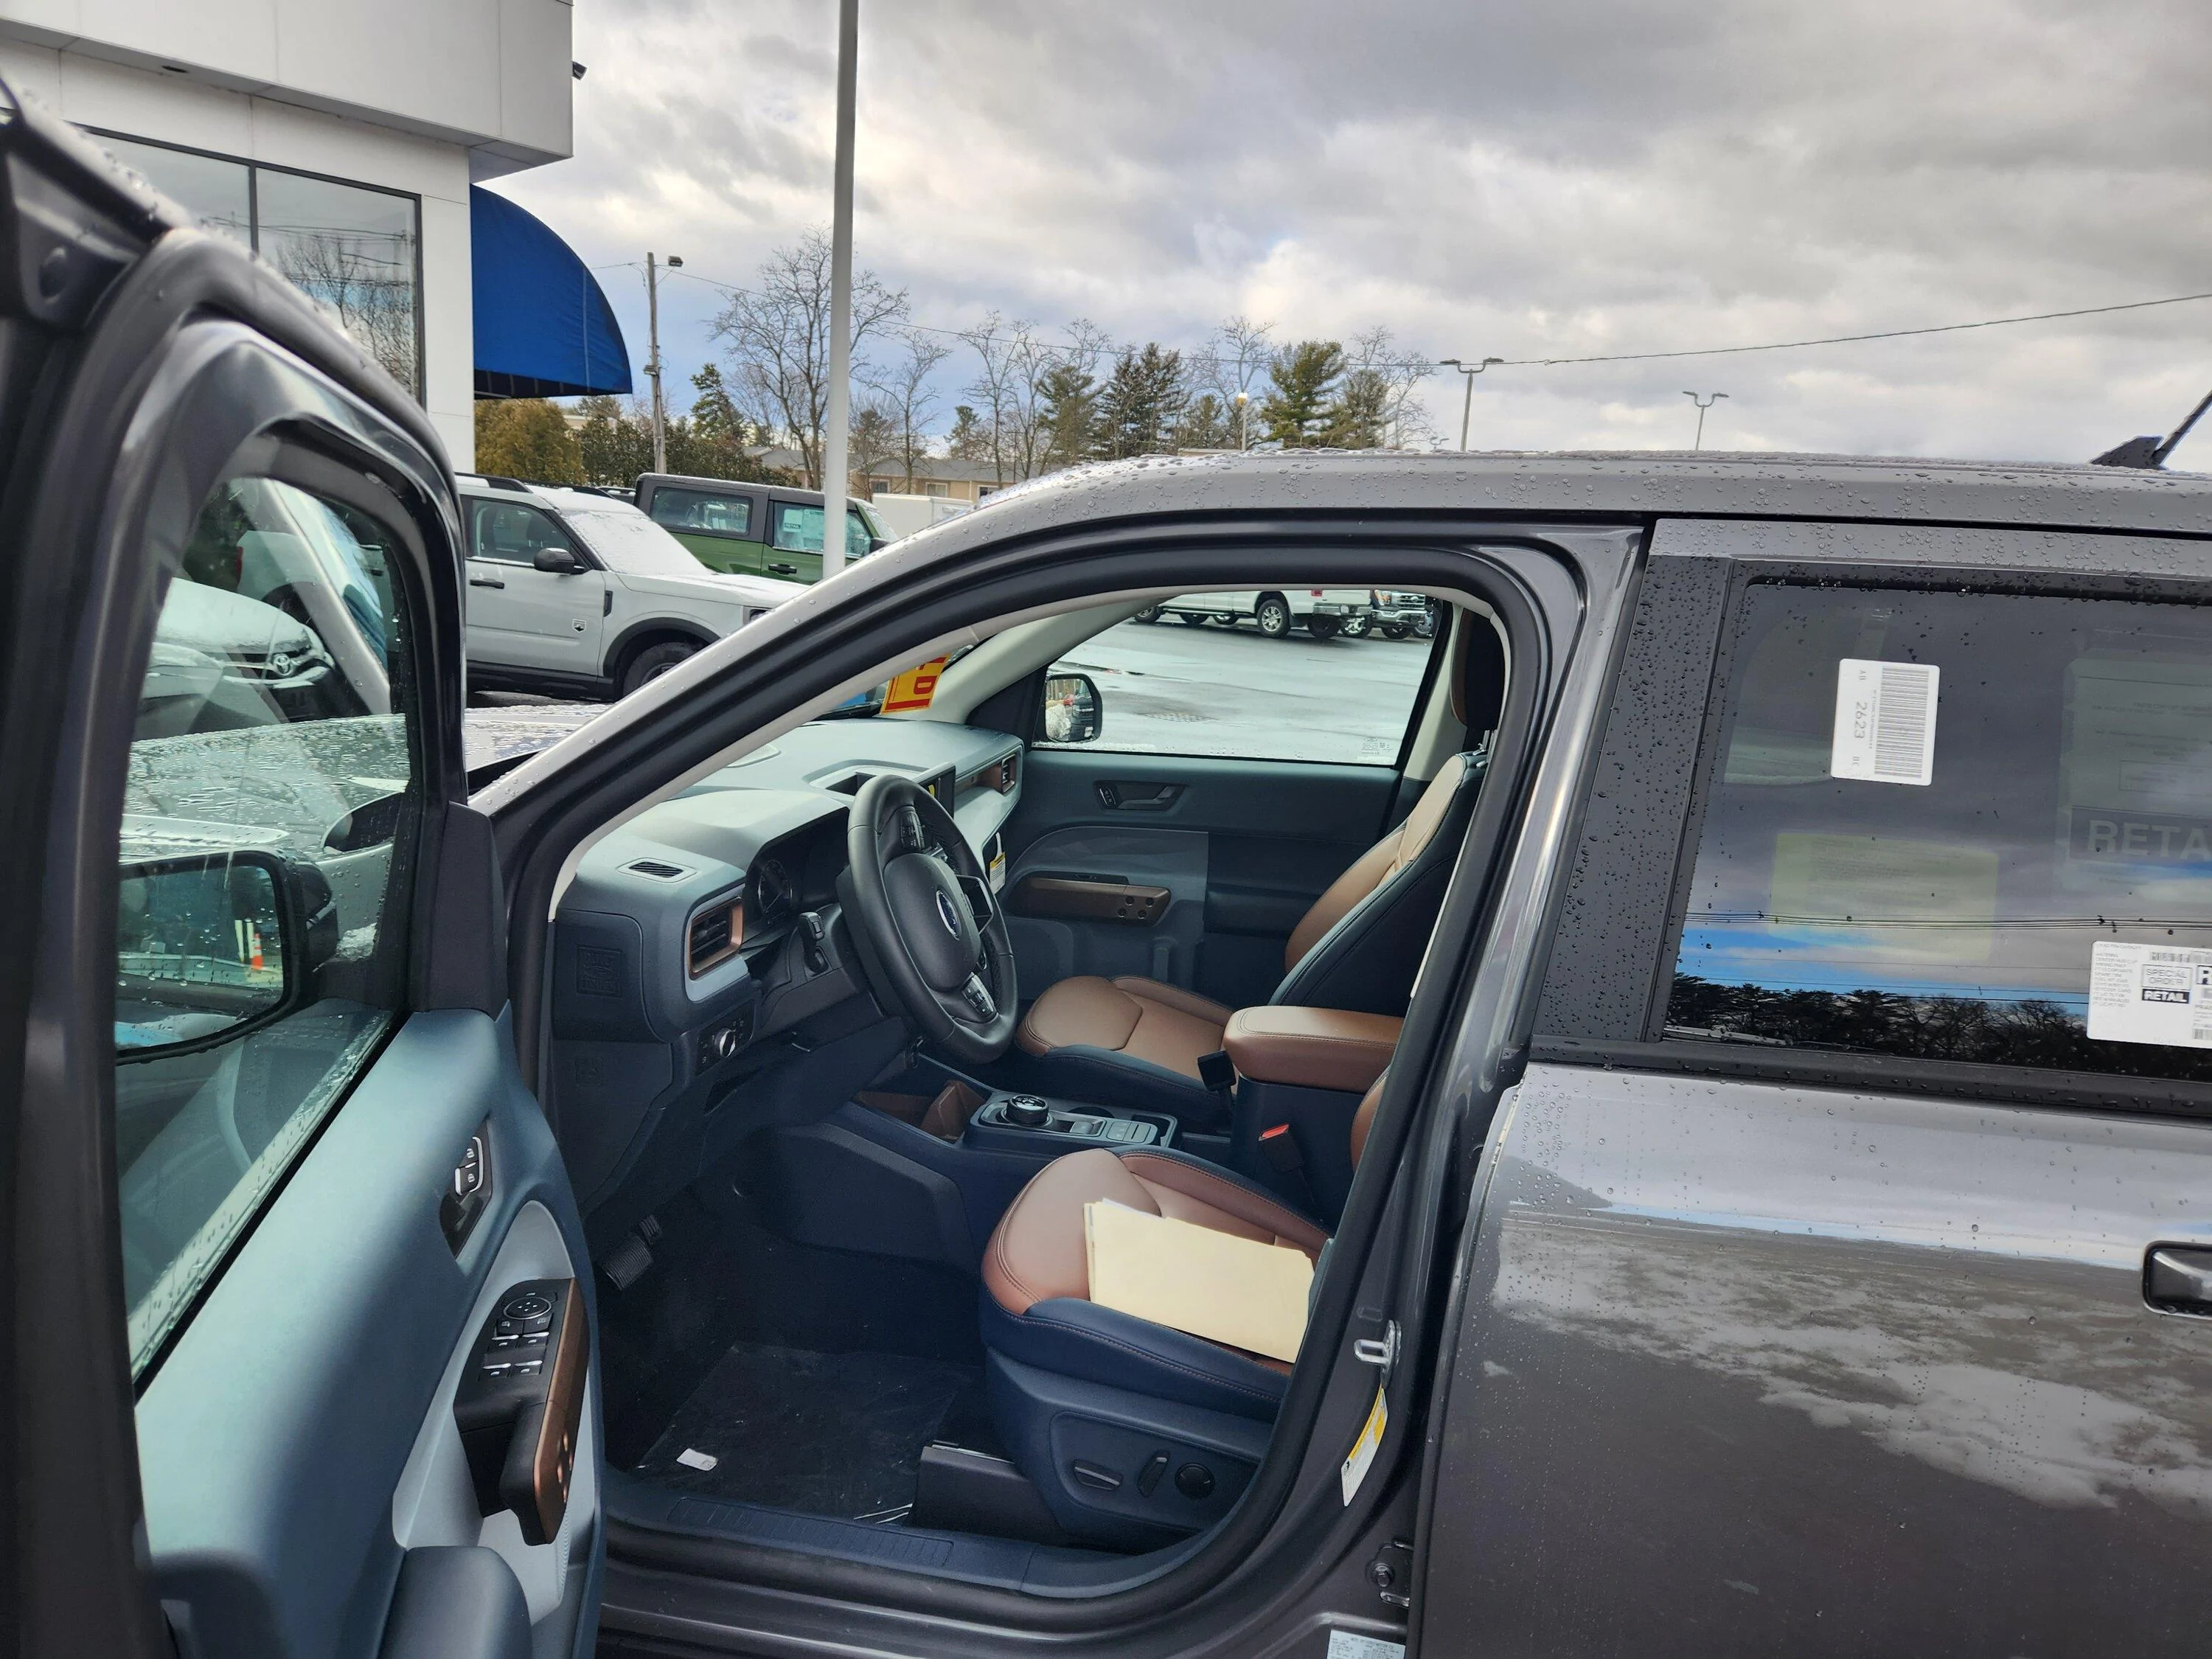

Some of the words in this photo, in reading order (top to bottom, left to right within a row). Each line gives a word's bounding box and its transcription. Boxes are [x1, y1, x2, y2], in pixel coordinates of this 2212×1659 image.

[1854, 702, 1868, 740] 2623
[2087, 819, 2212, 862] RETA
[2146, 968, 2188, 978] SPECIAL
[2149, 976, 2184, 985] ORDER
[2143, 990, 2188, 1003] RETAIL
